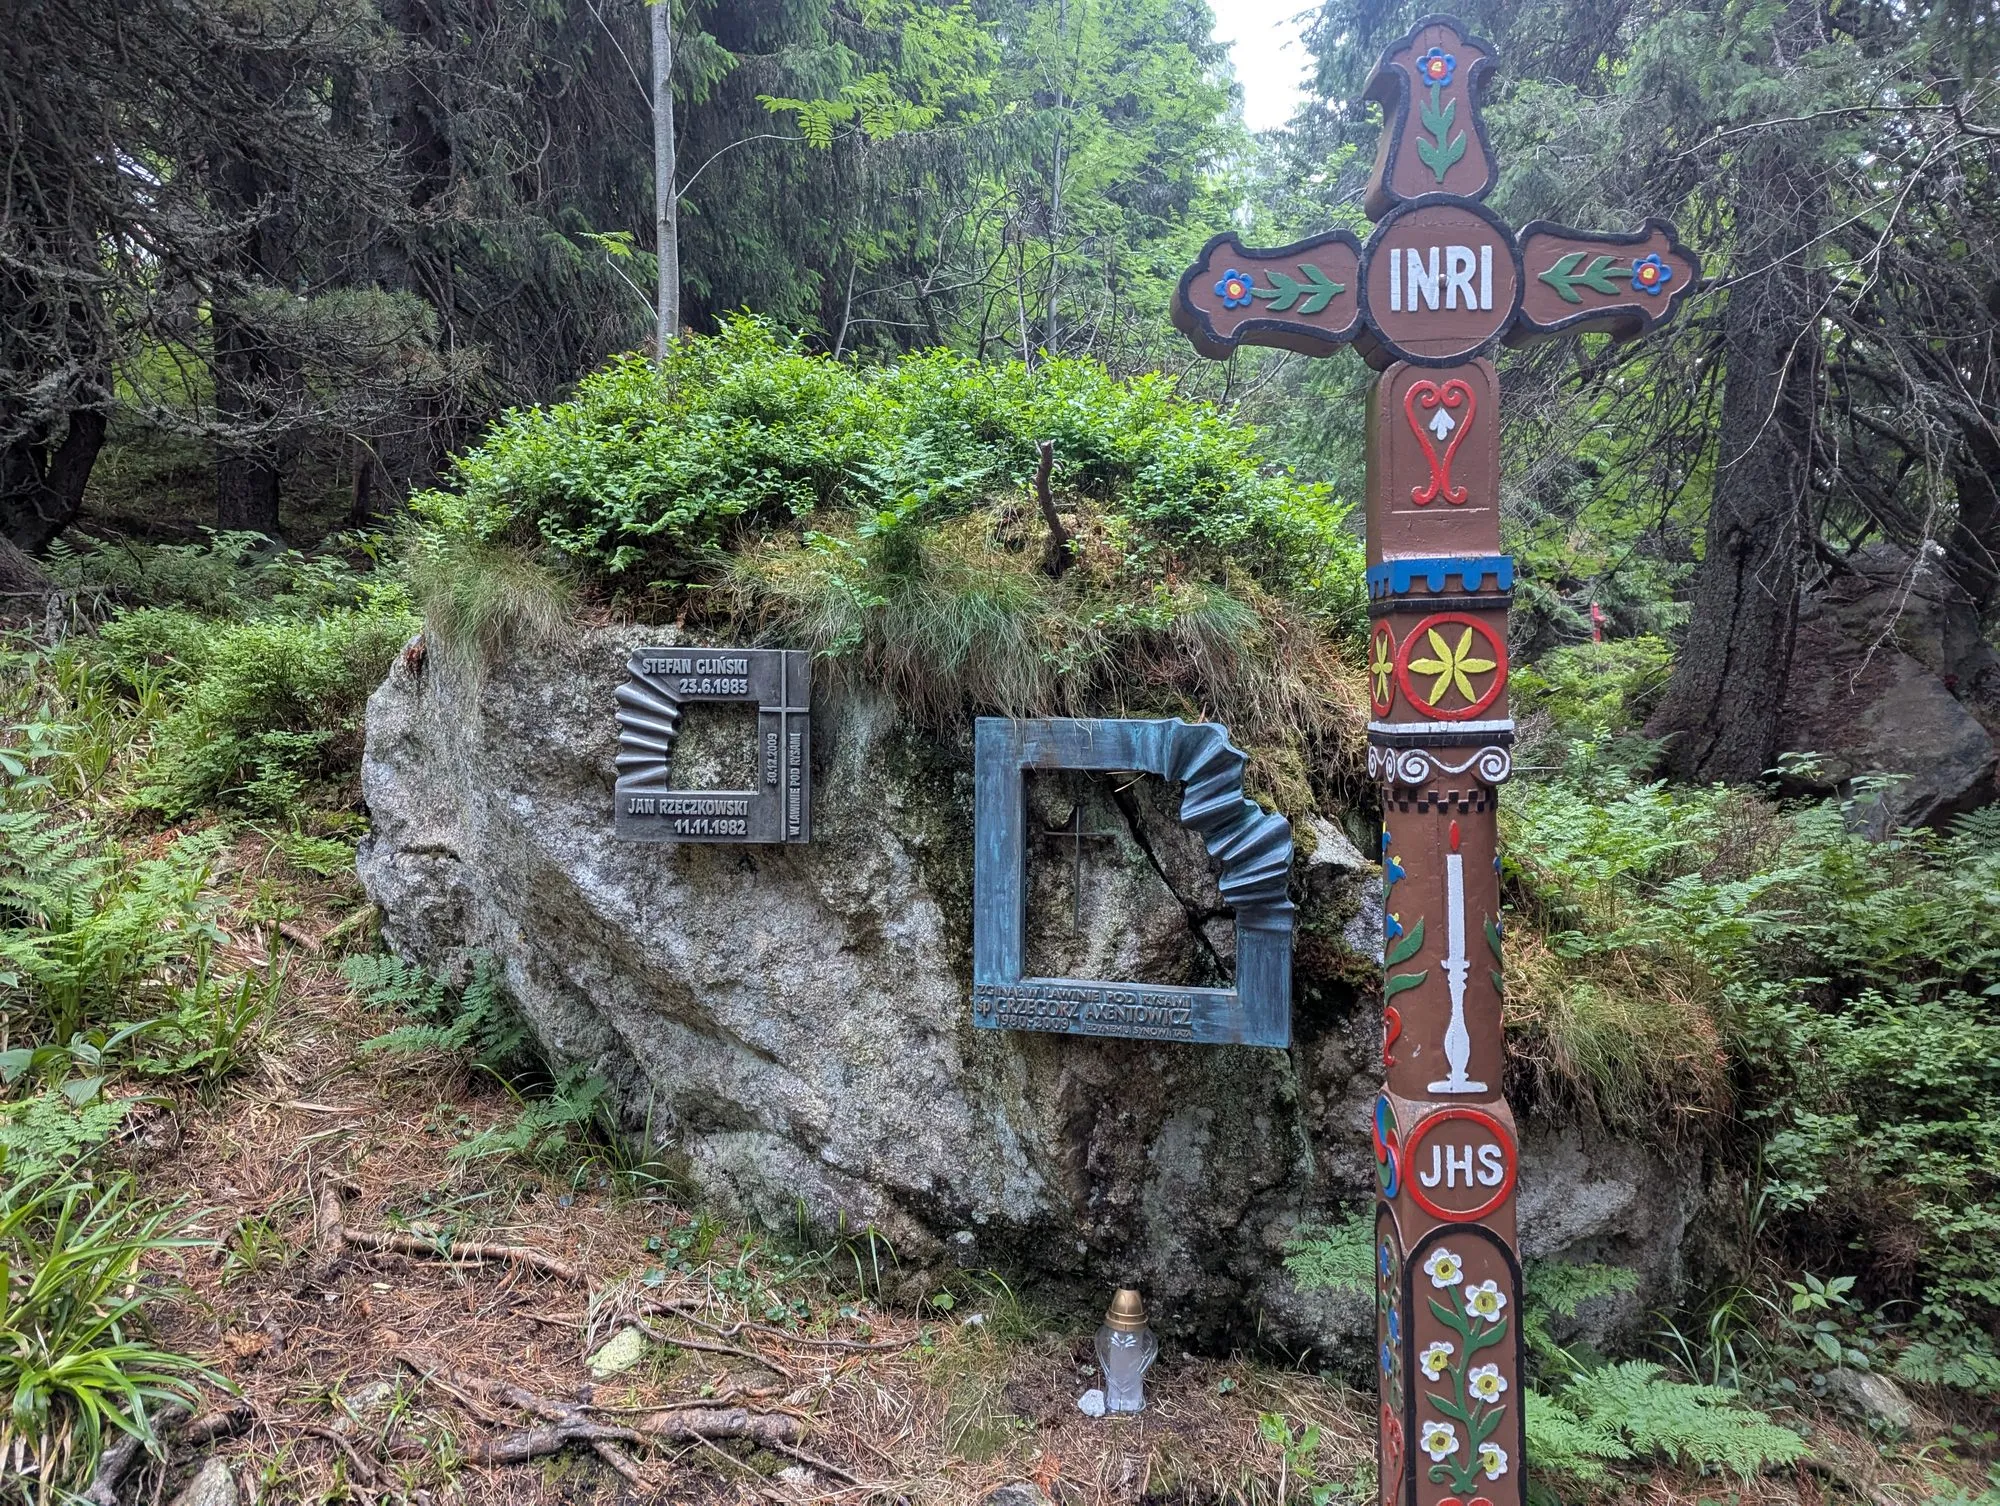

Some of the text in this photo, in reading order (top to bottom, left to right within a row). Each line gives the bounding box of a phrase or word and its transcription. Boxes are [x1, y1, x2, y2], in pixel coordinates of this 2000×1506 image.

[1390, 245, 1492, 312] INRI
[642, 656, 748, 675] STEFAN GLIŃSKI
[679, 678, 748, 695] 23.6.1983
[767, 733, 778, 784] 30.12.2009
[790, 733, 801, 836] W LAWINIE POD RYSAMI
[628, 798, 748, 816] JAN RZECZKOWSKI
[674, 819, 747, 836] 11.11.1982
[1045, 987, 1101, 1003] LAWINIE
[1106, 990, 1137, 1005] POD
[1141, 993, 1192, 1009] RYSAMI
[995, 997, 1080, 1018] GRZEGORZ
[1084, 1002, 1193, 1026] AXENTOWICZ
[995, 1014, 1070, 1030] 1980-2009
[1420, 1143, 1504, 1188] JHS
